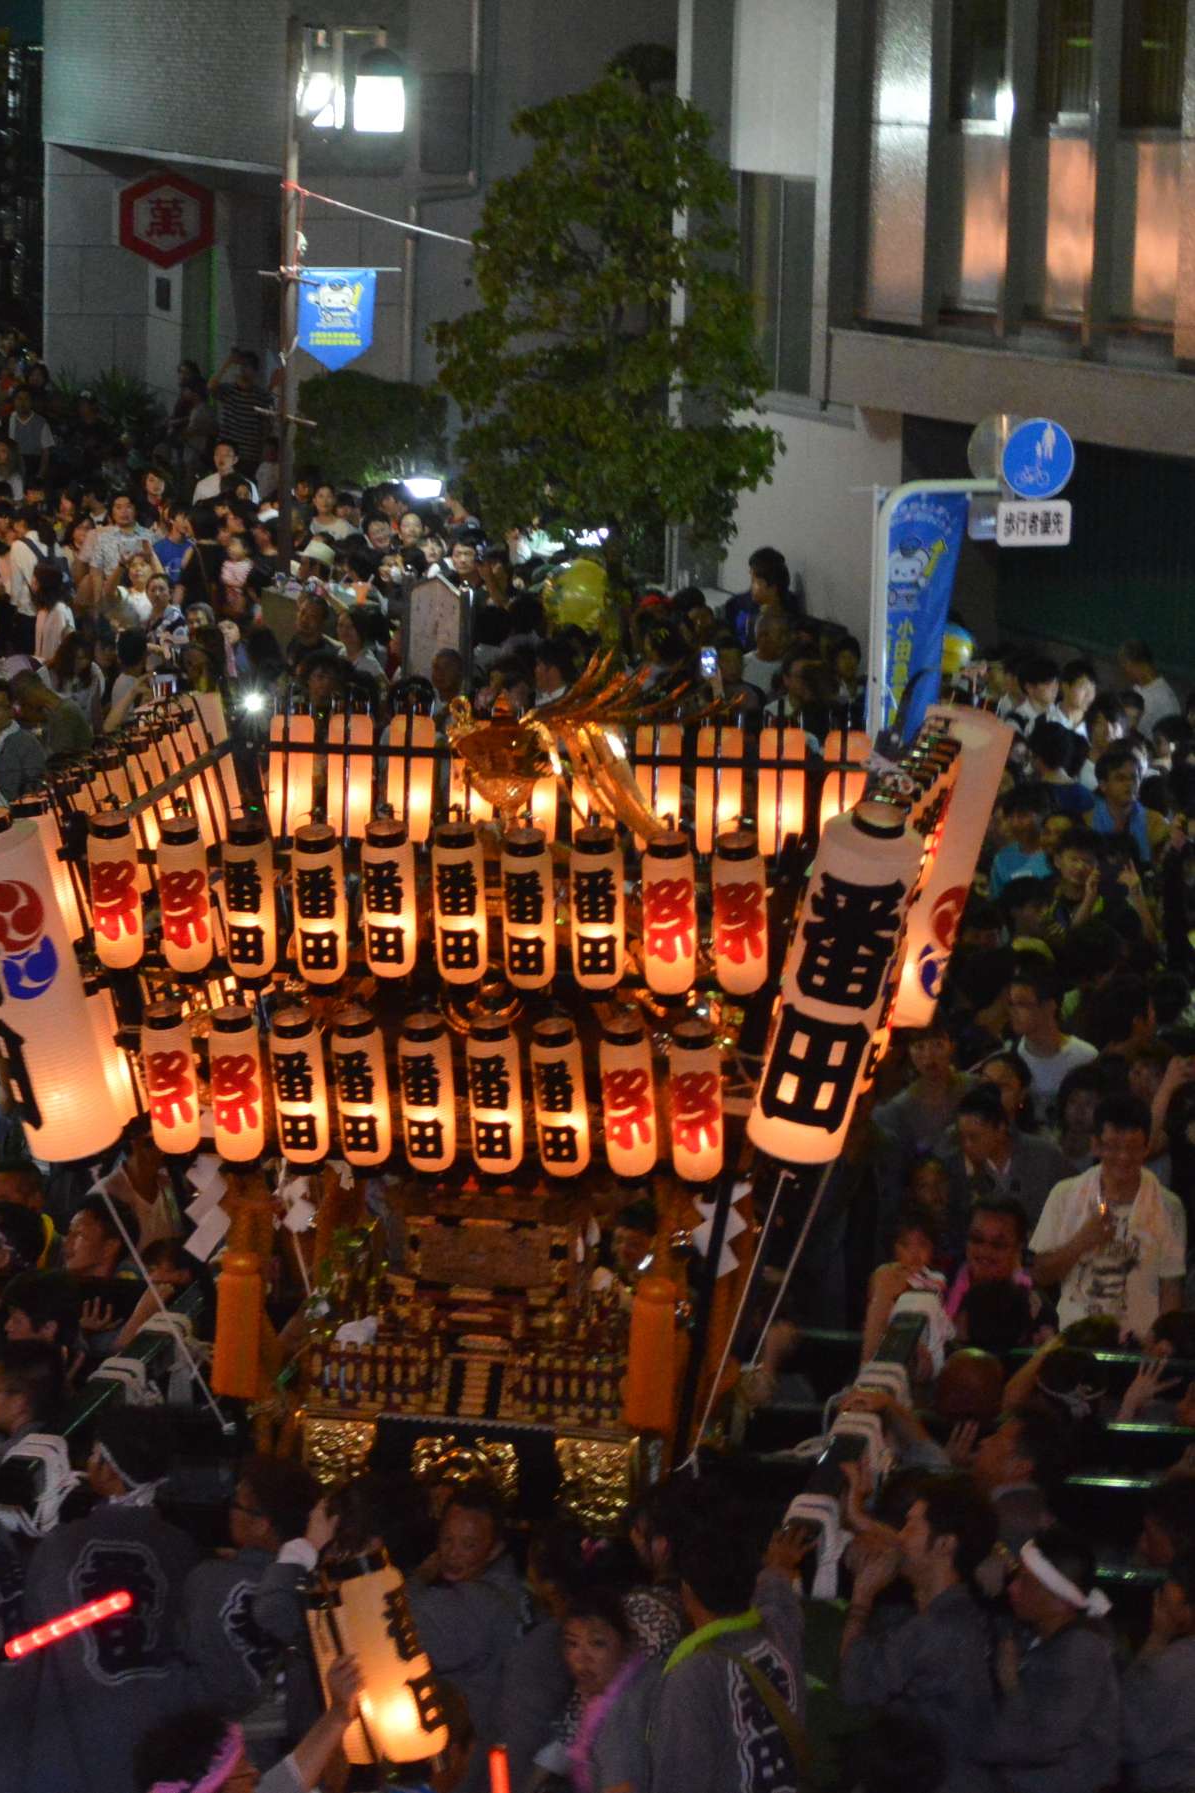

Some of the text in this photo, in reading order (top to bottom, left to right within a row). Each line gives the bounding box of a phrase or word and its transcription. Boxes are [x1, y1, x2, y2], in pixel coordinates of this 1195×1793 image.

[1004, 511, 1063, 537] 歩行者優先
[91, 859, 139, 942] 祭
[160, 869, 209, 949] 祭
[224, 859, 264, 965] 番田
[296, 865, 339, 970] 番田
[363, 860, 405, 964] 番田
[437, 860, 481, 969] 番田
[504, 870, 546, 975] 番田
[572, 867, 618, 975] 番田
[644, 877, 695, 964] 祭
[714, 880, 765, 965] 祭
[760, 873, 907, 1133] 番田
[146, 1050, 194, 1131] 祭
[212, 1054, 259, 1134] 祭
[272, 1050, 319, 1151] 番田
[335, 1050, 379, 1153] 番田
[401, 1054, 445, 1160] 番田
[469, 1056, 513, 1161] 番田
[536, 1060, 578, 1162] 番田
[602, 1068, 651, 1151] 祭
[670, 1070, 720, 1154] 祭
